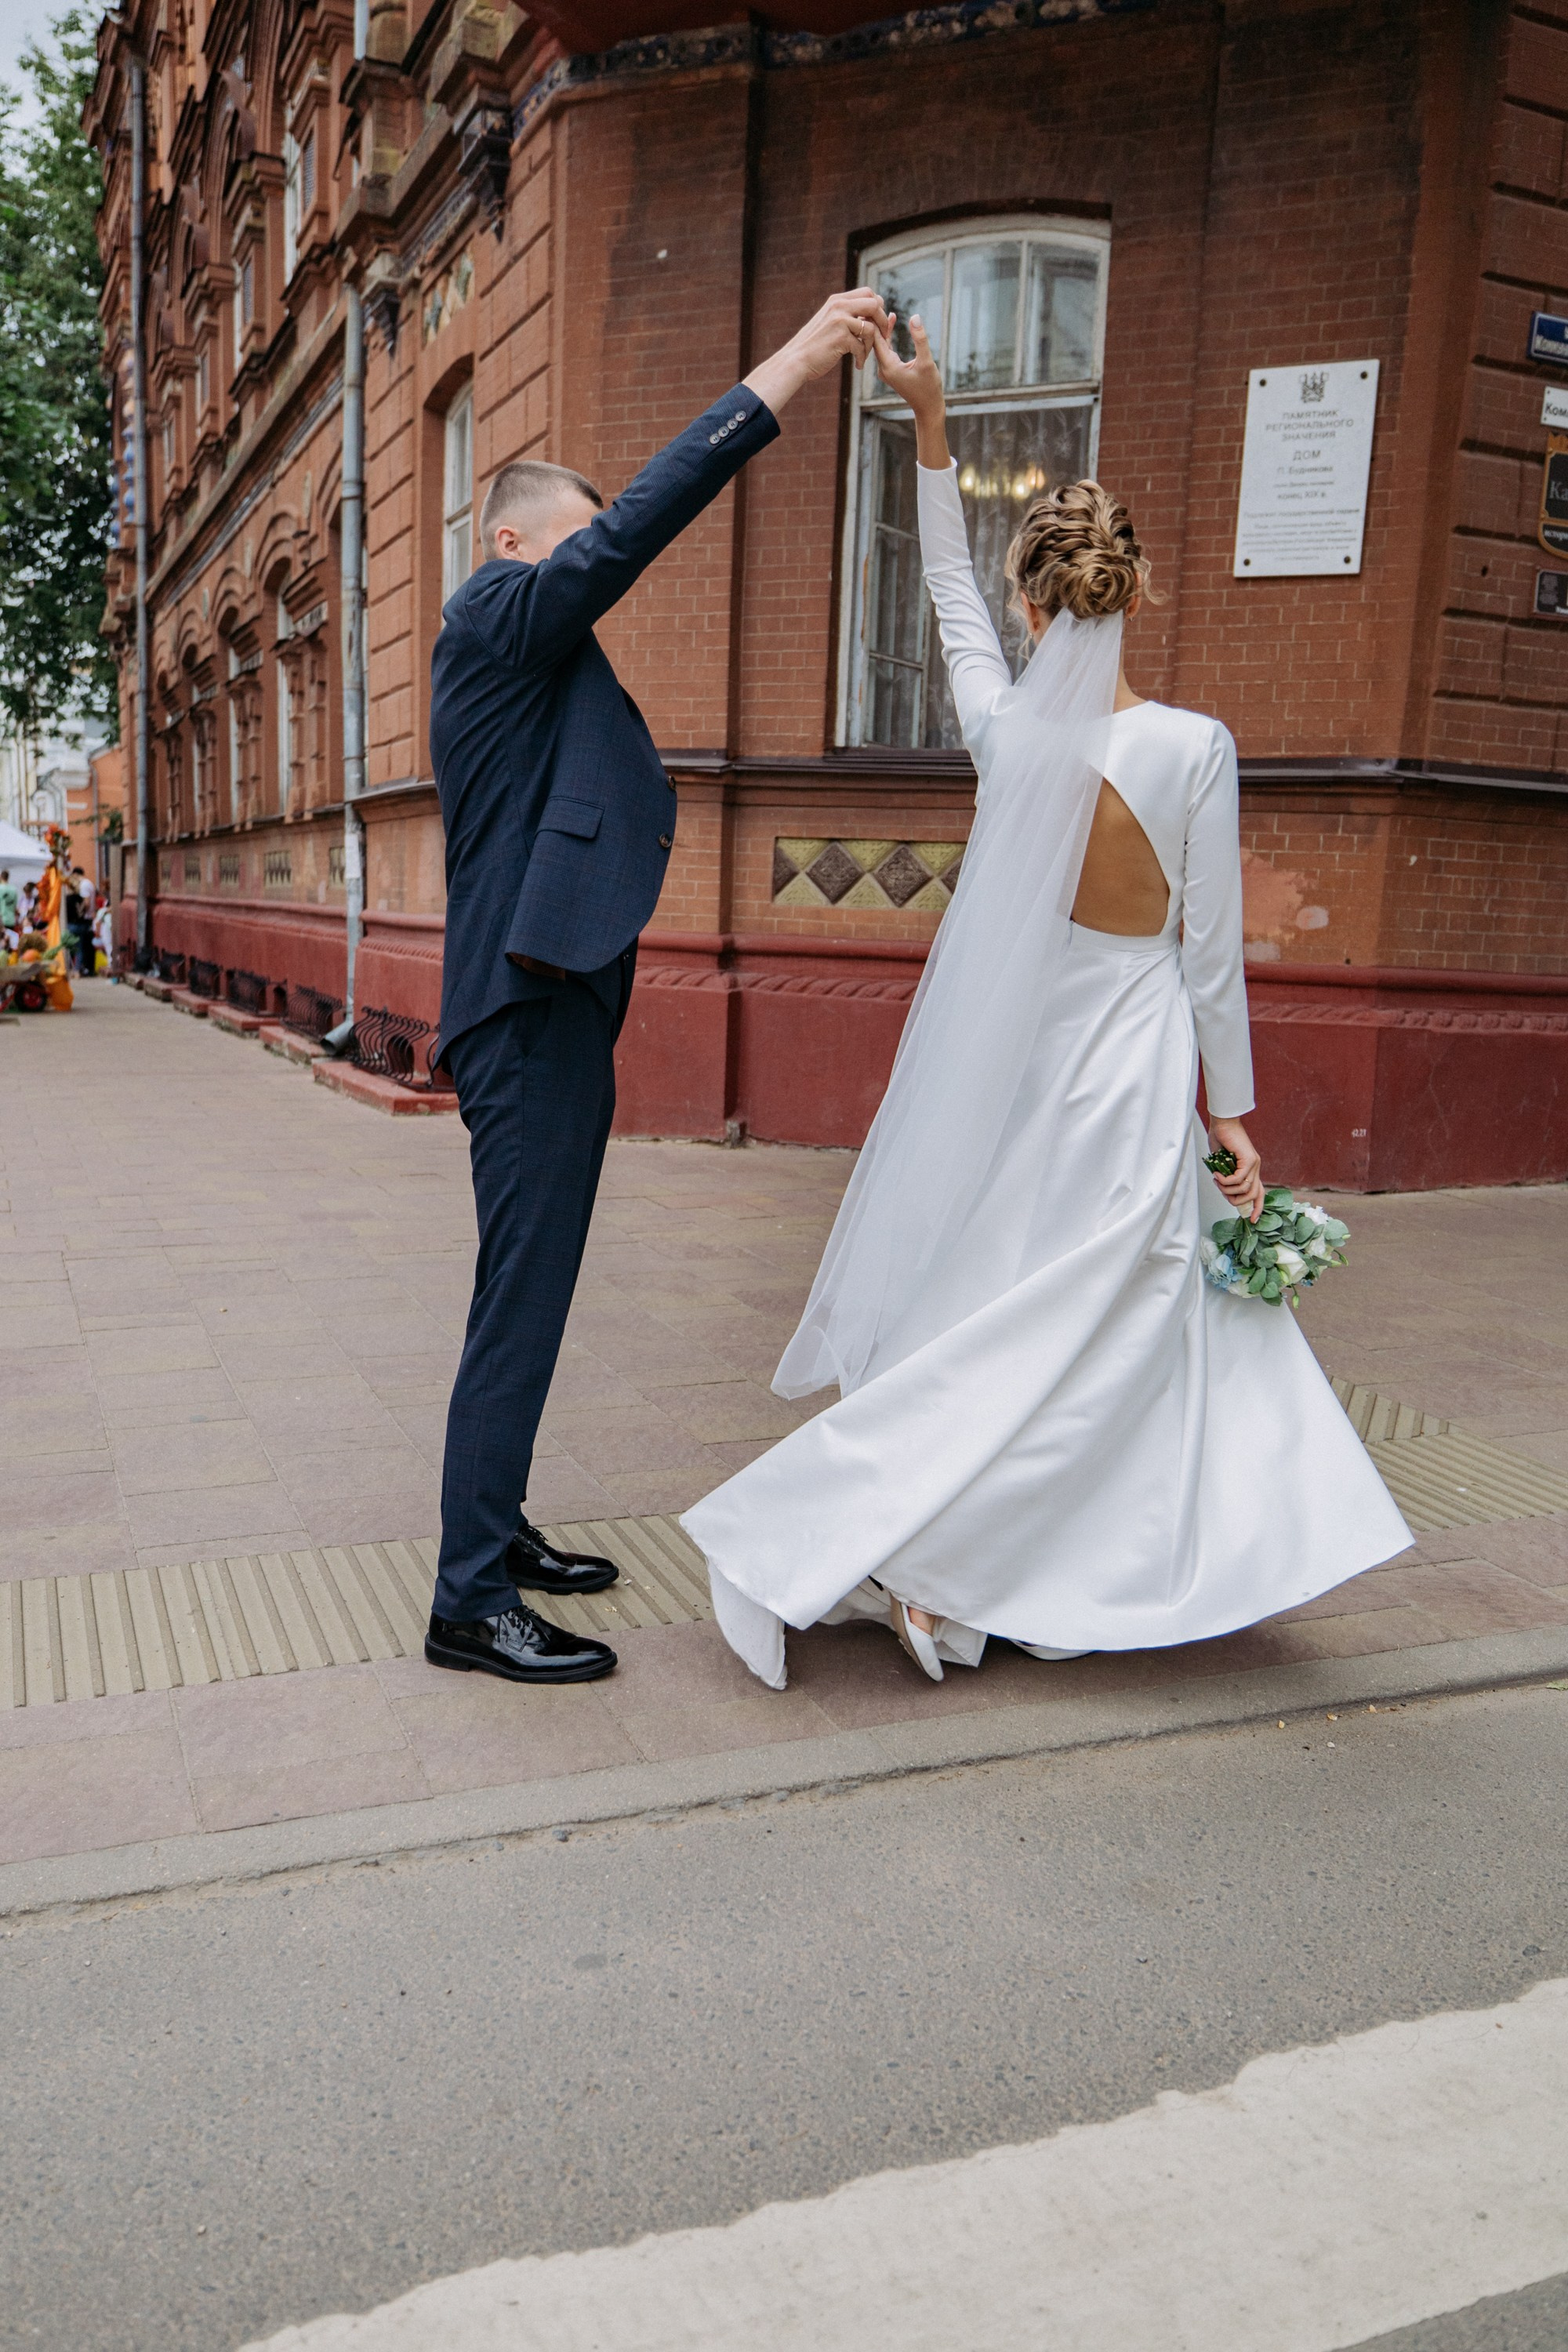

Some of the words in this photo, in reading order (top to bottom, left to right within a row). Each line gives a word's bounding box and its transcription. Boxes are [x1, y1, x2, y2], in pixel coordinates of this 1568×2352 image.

[1283, 410, 1338, 419] ПАМЯТНИК
[1545, 404, 1568, 417] Ком
[1266, 419, 1353, 430] РЕГИОНАЛЬНОГО
[1283, 431, 1335, 441] ЗНАЧЕНИЯ
[1294, 450, 1320, 460] ДОМ
